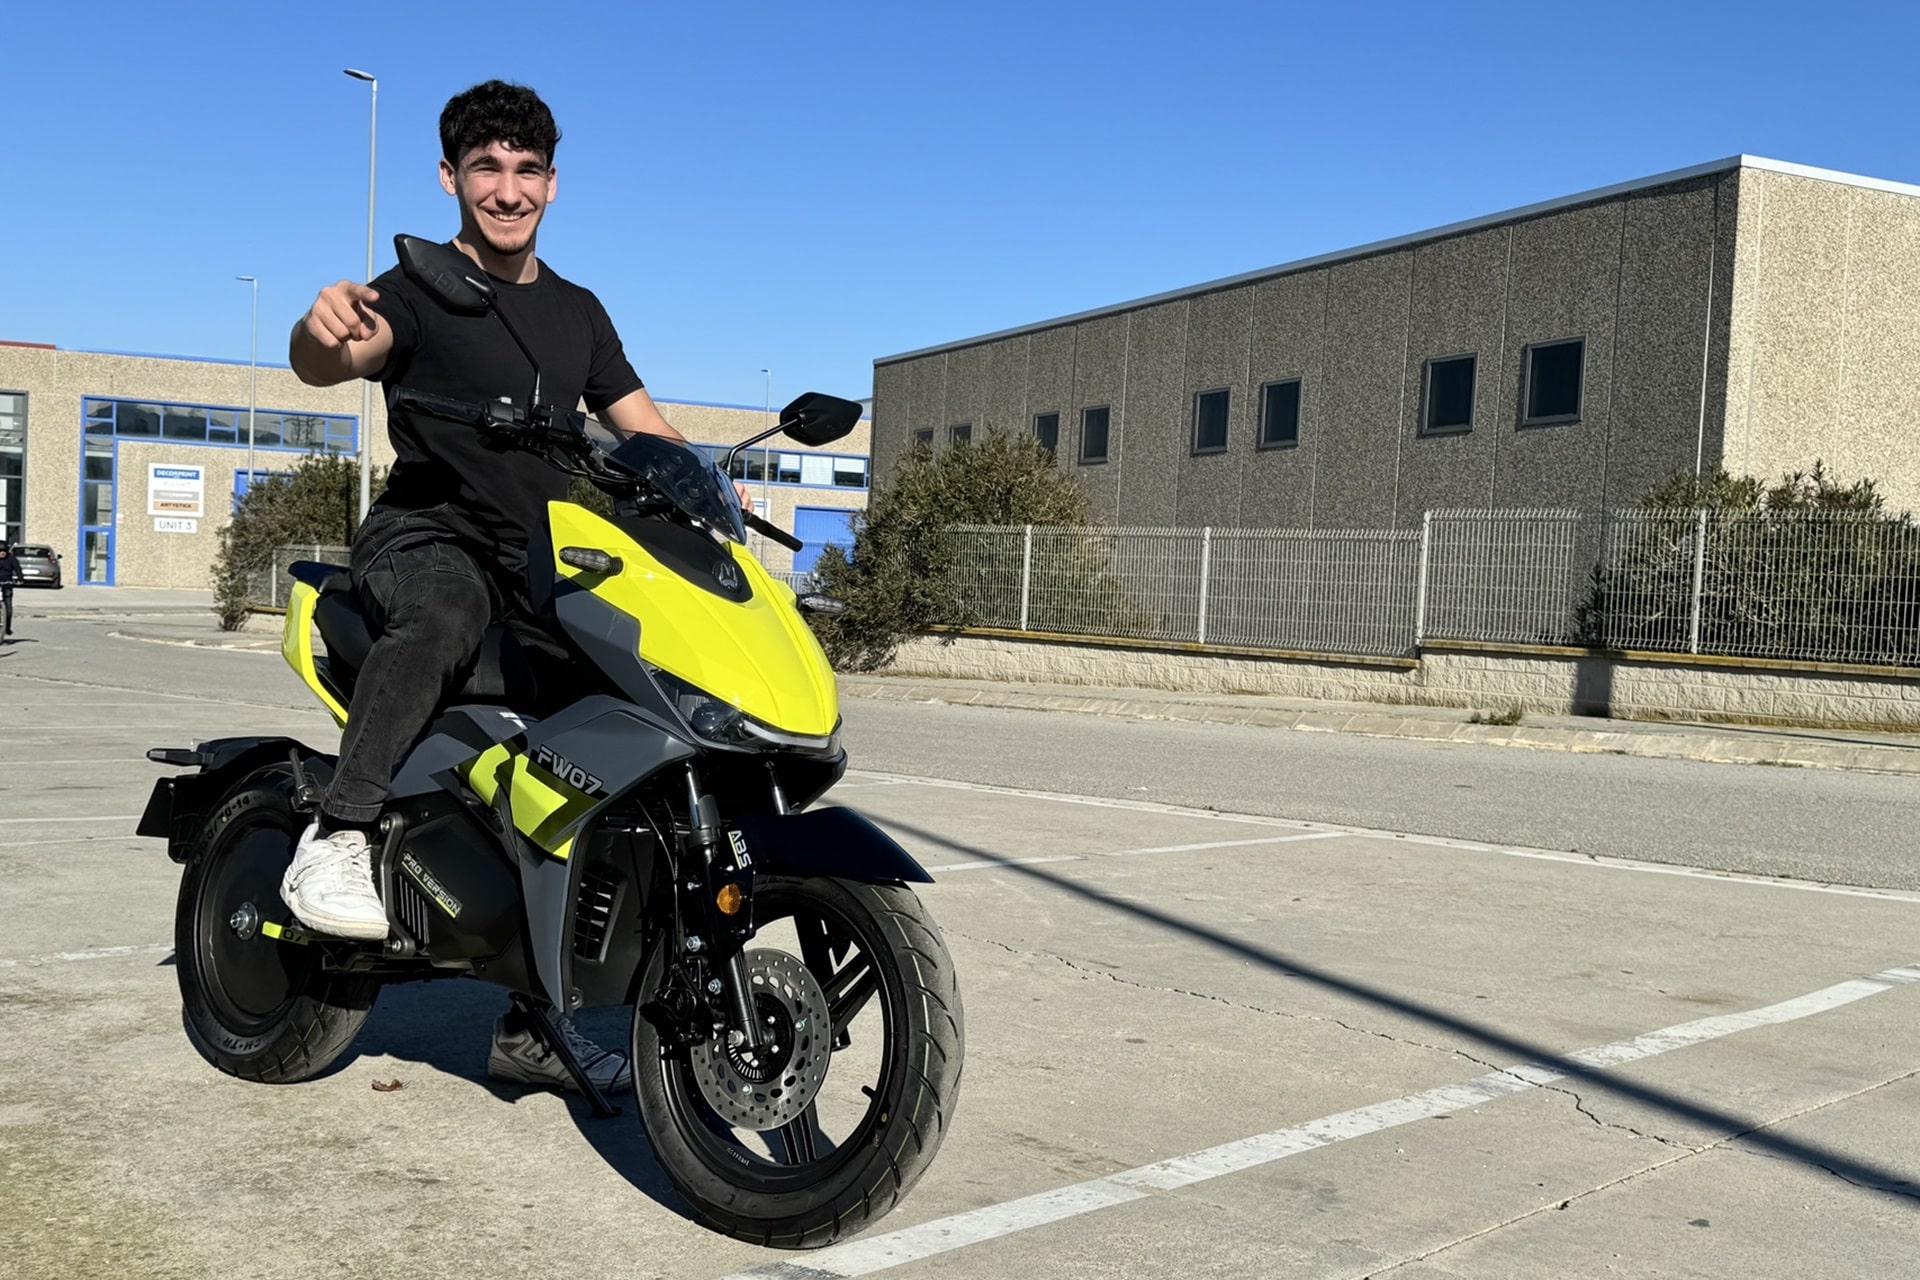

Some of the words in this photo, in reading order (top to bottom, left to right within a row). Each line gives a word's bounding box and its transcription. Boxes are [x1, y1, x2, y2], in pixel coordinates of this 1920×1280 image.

[159, 520, 182, 529] UNIT
[186, 521, 192, 530] 3
[537, 744, 603, 795] FW07
[731, 829, 752, 868] ABS
[403, 853, 422, 875] PRO
[422, 873, 462, 914] VERSION
